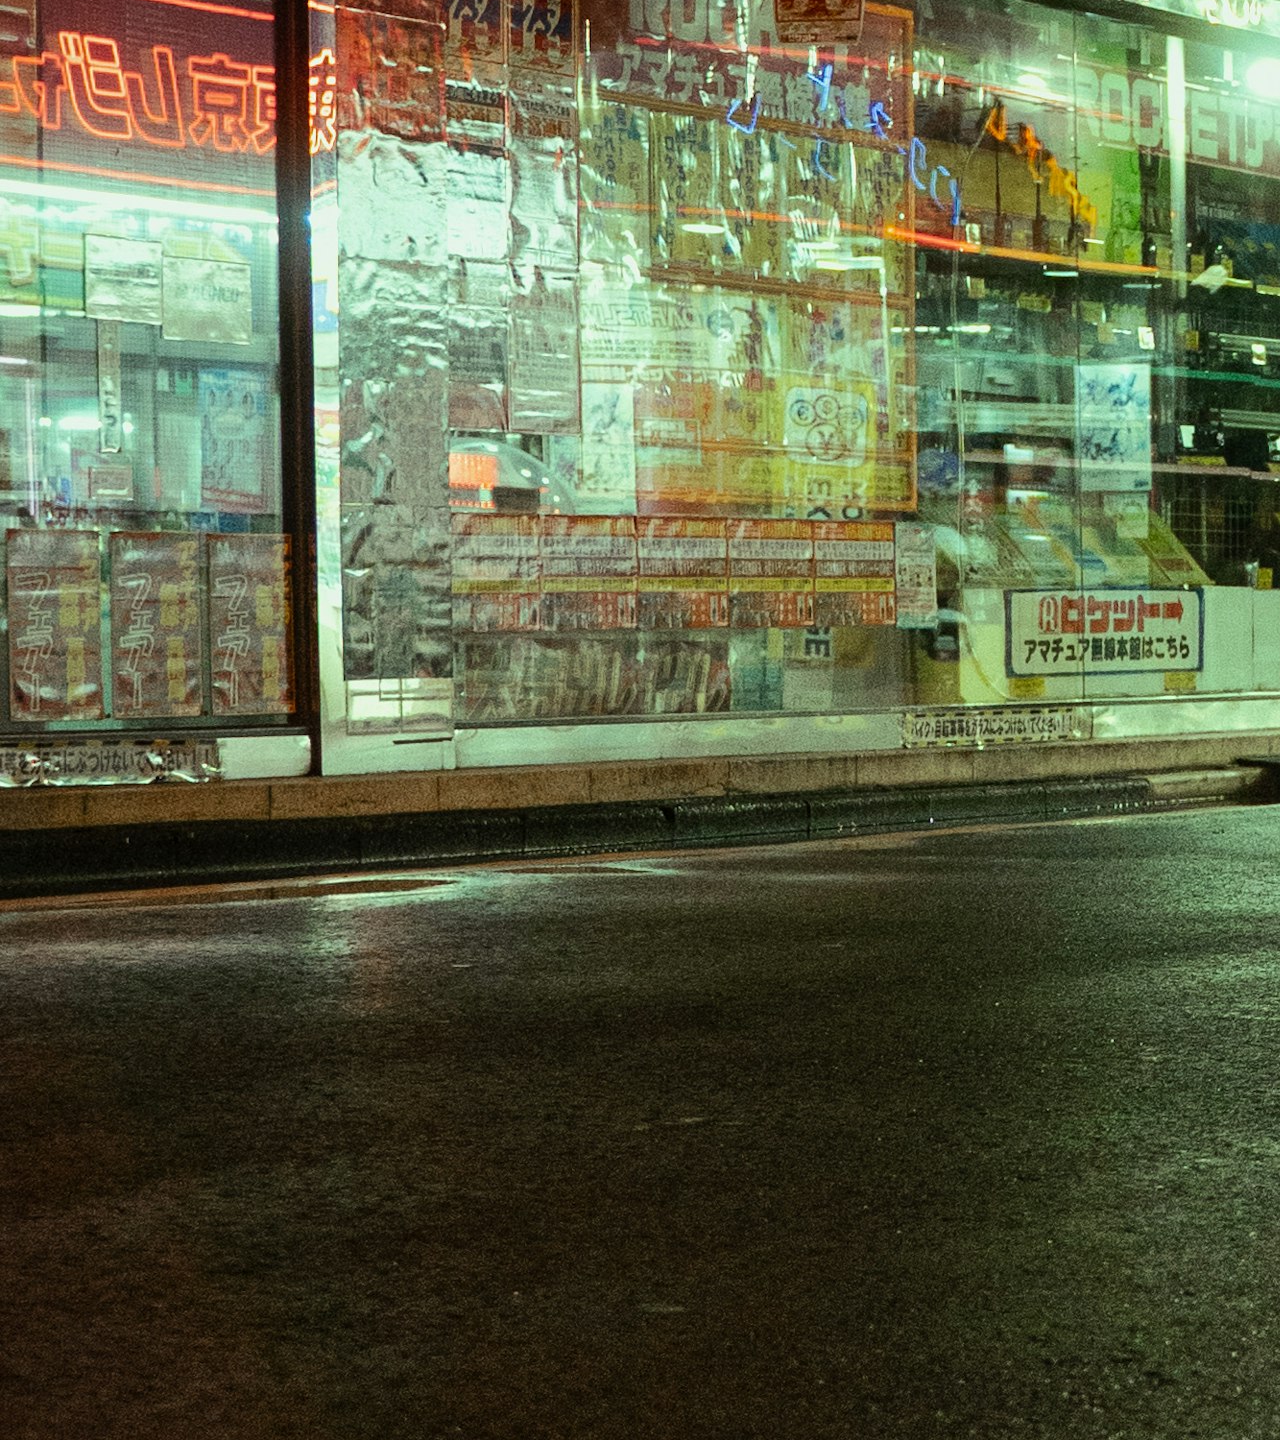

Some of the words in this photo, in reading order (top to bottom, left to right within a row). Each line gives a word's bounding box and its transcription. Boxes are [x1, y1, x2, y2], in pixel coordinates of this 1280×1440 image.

[1061, 595, 1161, 637] ロケット
[1023, 634, 1191, 665] アマチュア無線本館はこちら
